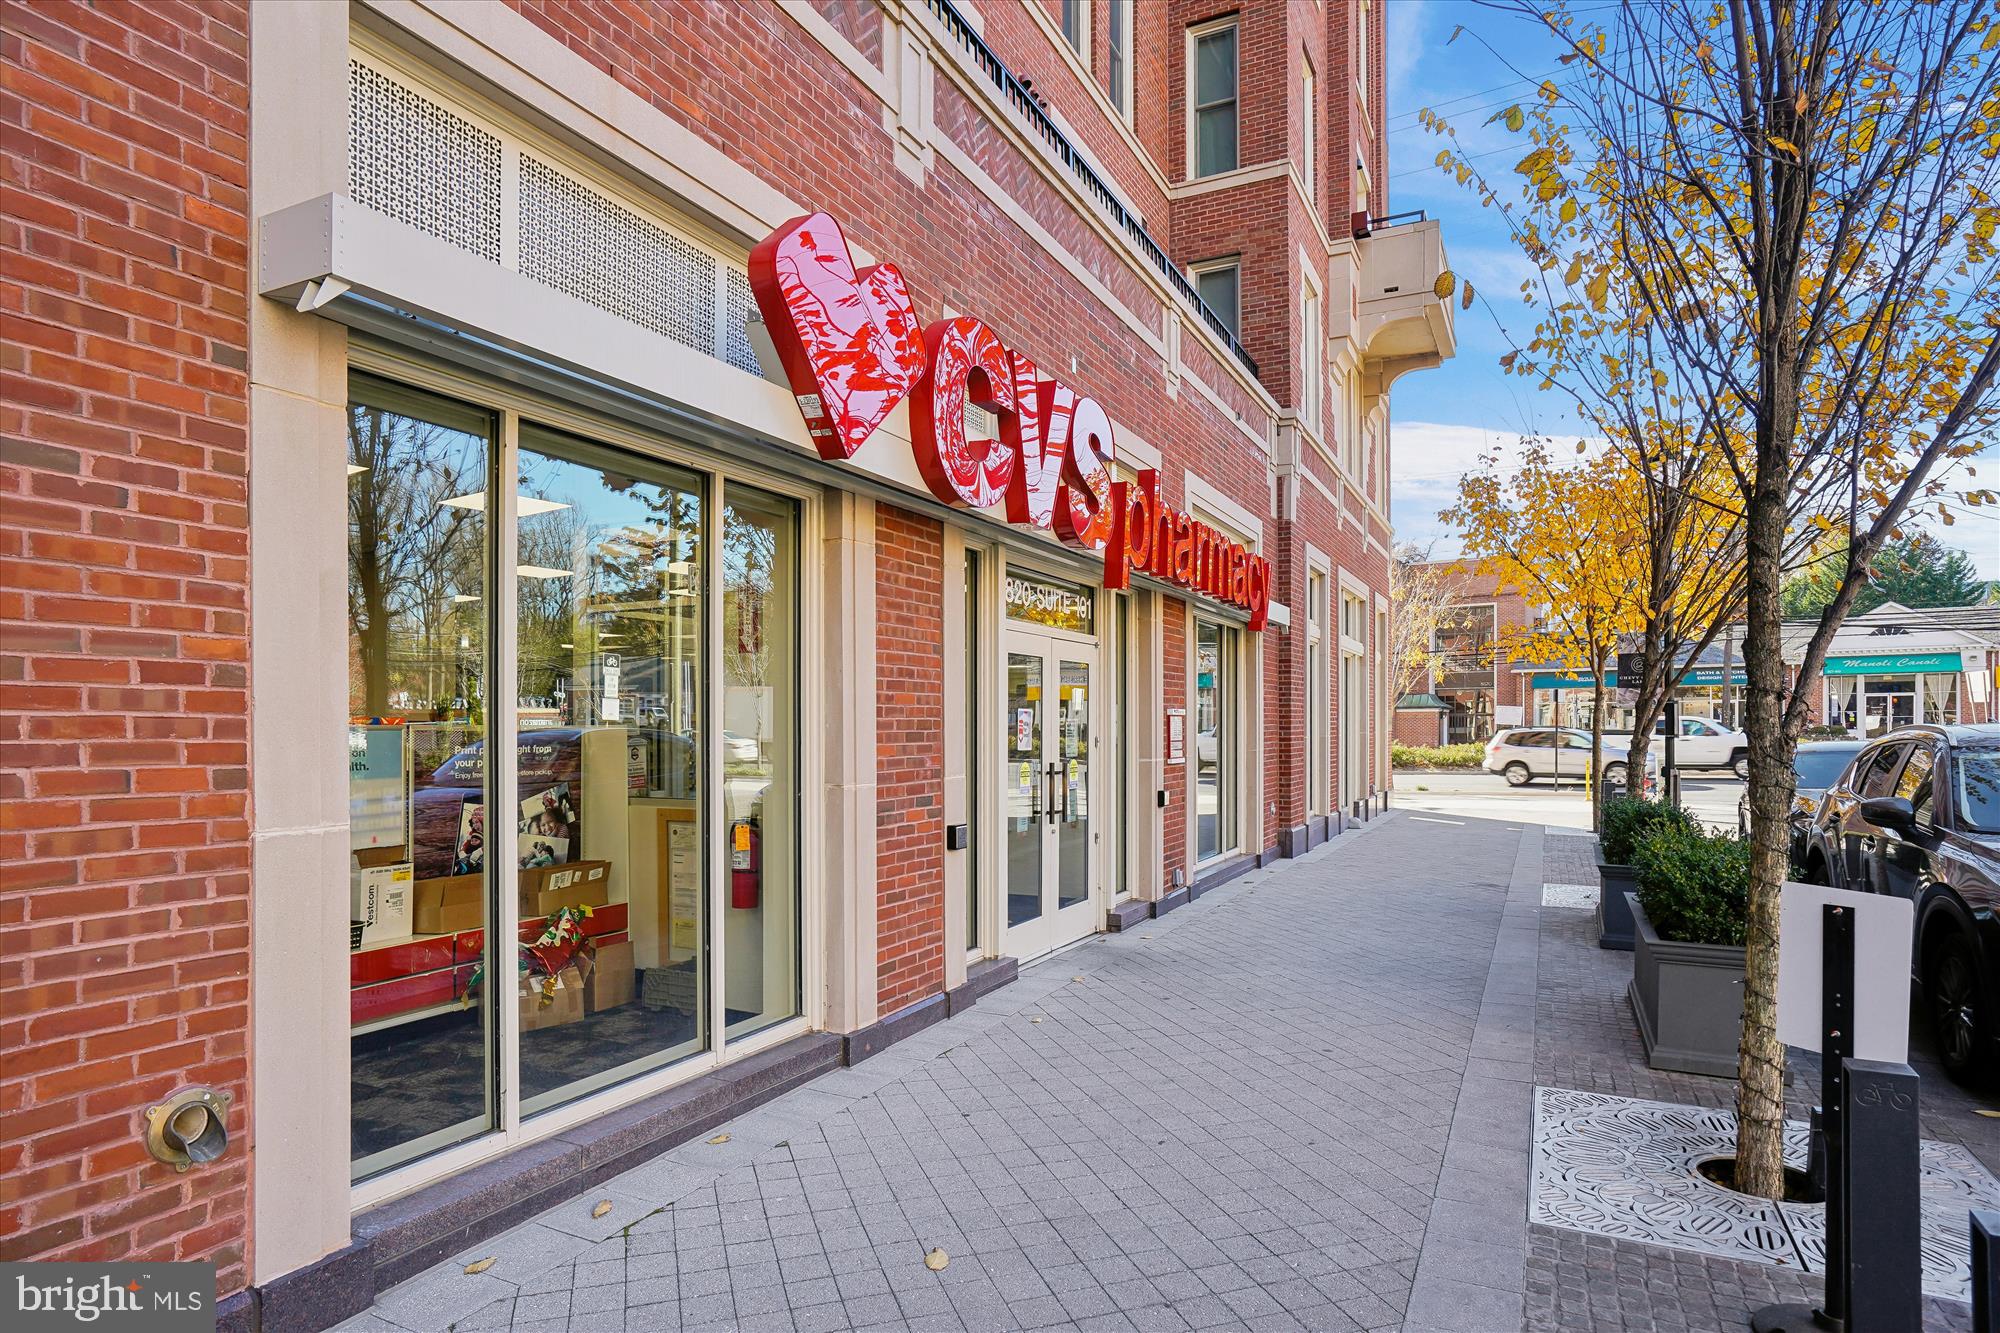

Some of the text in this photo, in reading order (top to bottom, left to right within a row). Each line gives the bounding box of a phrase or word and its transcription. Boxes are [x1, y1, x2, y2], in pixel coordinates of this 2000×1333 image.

[910, 317, 1272, 632] CVS pharmacy
[1036, 585, 1071, 614] SUITE
[1075, 595, 1092, 620] 101
[1843, 657, 1941, 667] Manoli Canoli
[454, 745, 476, 755] Print
[532, 744, 552, 753] from
[454, 760, 475, 769] your
[455, 772, 471, 780] Enjoy
[366, 883, 375, 927] Vestcom
